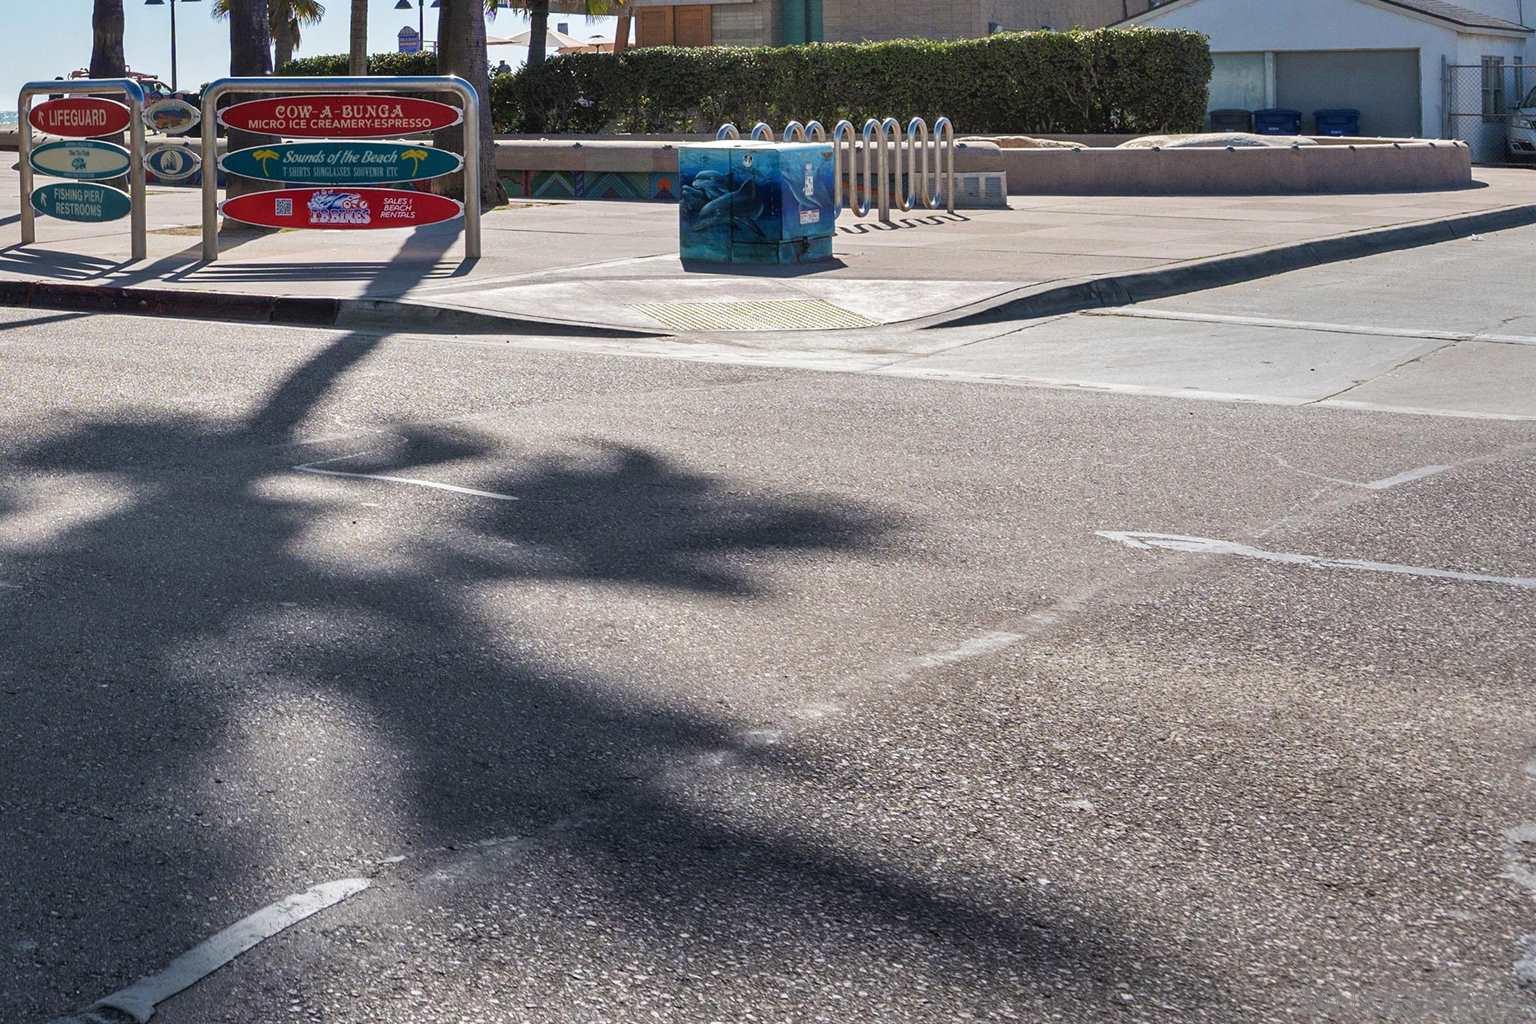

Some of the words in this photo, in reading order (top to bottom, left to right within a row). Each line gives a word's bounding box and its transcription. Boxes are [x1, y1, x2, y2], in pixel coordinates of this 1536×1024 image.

[49, 109, 107, 126] LIFEGUARD
[275, 104, 404, 119] COW-A-BUNGA
[248, 119, 287, 129] MICRO
[289, 119, 307, 129] ICE
[283, 150, 325, 164] Sounds
[327, 150, 340, 165] of
[342, 150, 359, 164] the
[361, 150, 398, 164] Beach
[54, 188, 83, 201] FISHING
[383, 197, 408, 205] SALES
[56, 202, 102, 217] RESTROOMS
[383, 204, 413, 212] BEACH
[380, 211, 416, 219] RENTALS
